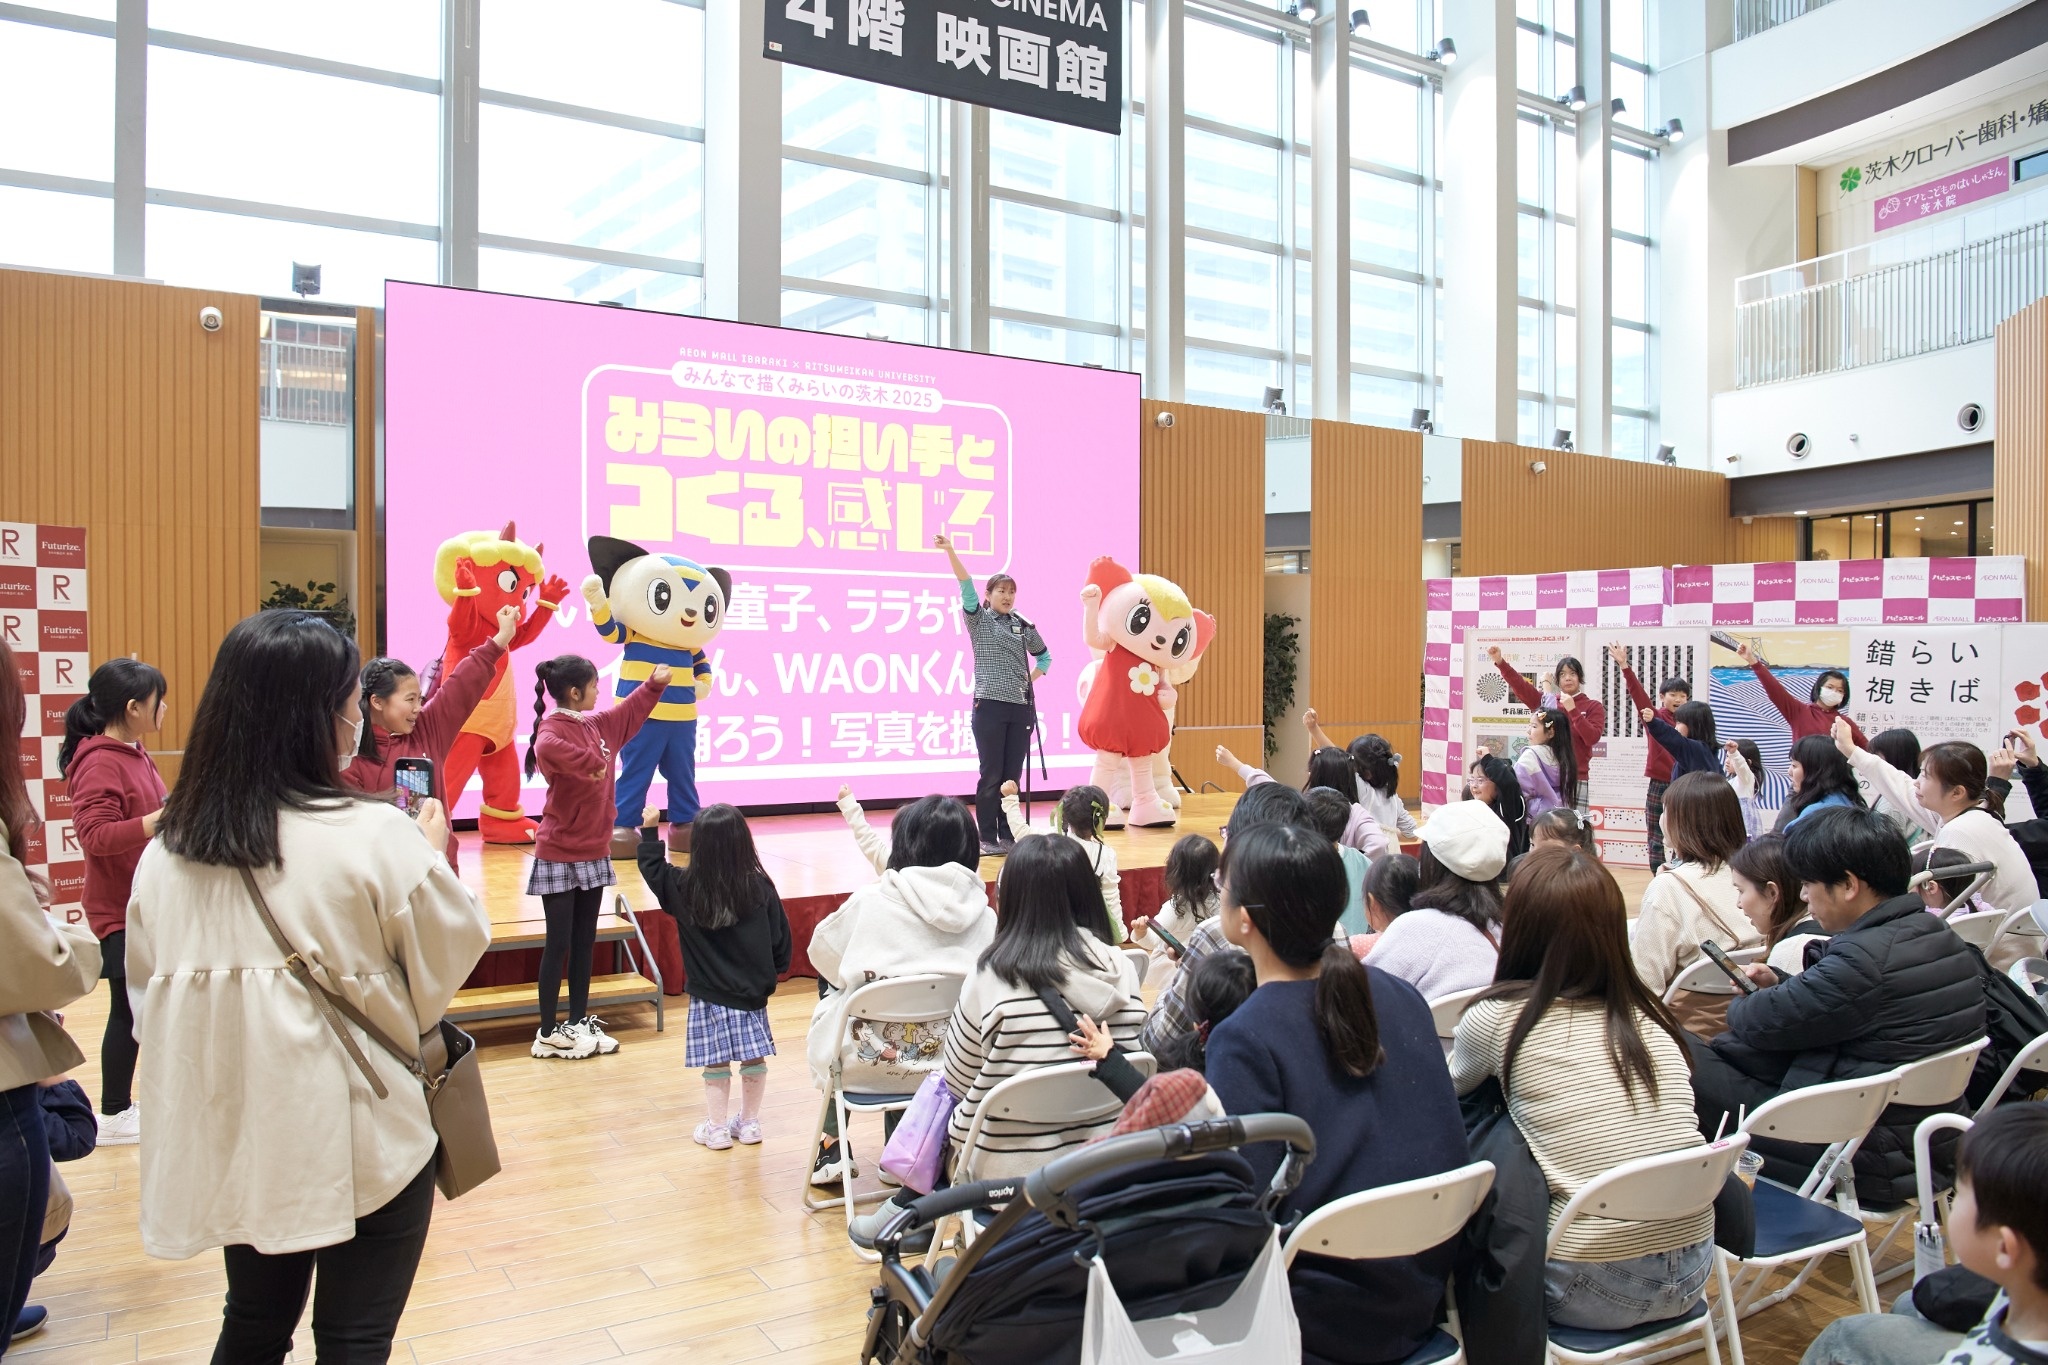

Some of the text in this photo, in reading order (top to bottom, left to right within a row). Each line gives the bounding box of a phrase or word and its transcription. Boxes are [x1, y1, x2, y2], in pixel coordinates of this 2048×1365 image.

[991, 0, 1108, 32] NEMA
[937, 12, 1109, 102] 映画館
[1920, 194, 1957, 215] 茨木院
[679, 347, 707, 358] AEON
[712, 351, 737, 362] MALL
[741, 354, 788, 368] IBARAKI
[804, 361, 875, 377] RITSUMEIKAN
[878, 370, 936, 384] UNIVERSITY
[604, 395, 996, 481] みらいの担い手と
[605, 462, 996, 557] つくる、感じる
[2, 529, 20, 556] R
[41, 541, 81, 551] Futurize.
[53, 574, 71, 601] R
[3, 615, 21, 642] R
[43, 625, 83, 634] Futurize.
[56, 658, 73, 684] R
[989, 1186, 1014, 1198] Aprica
